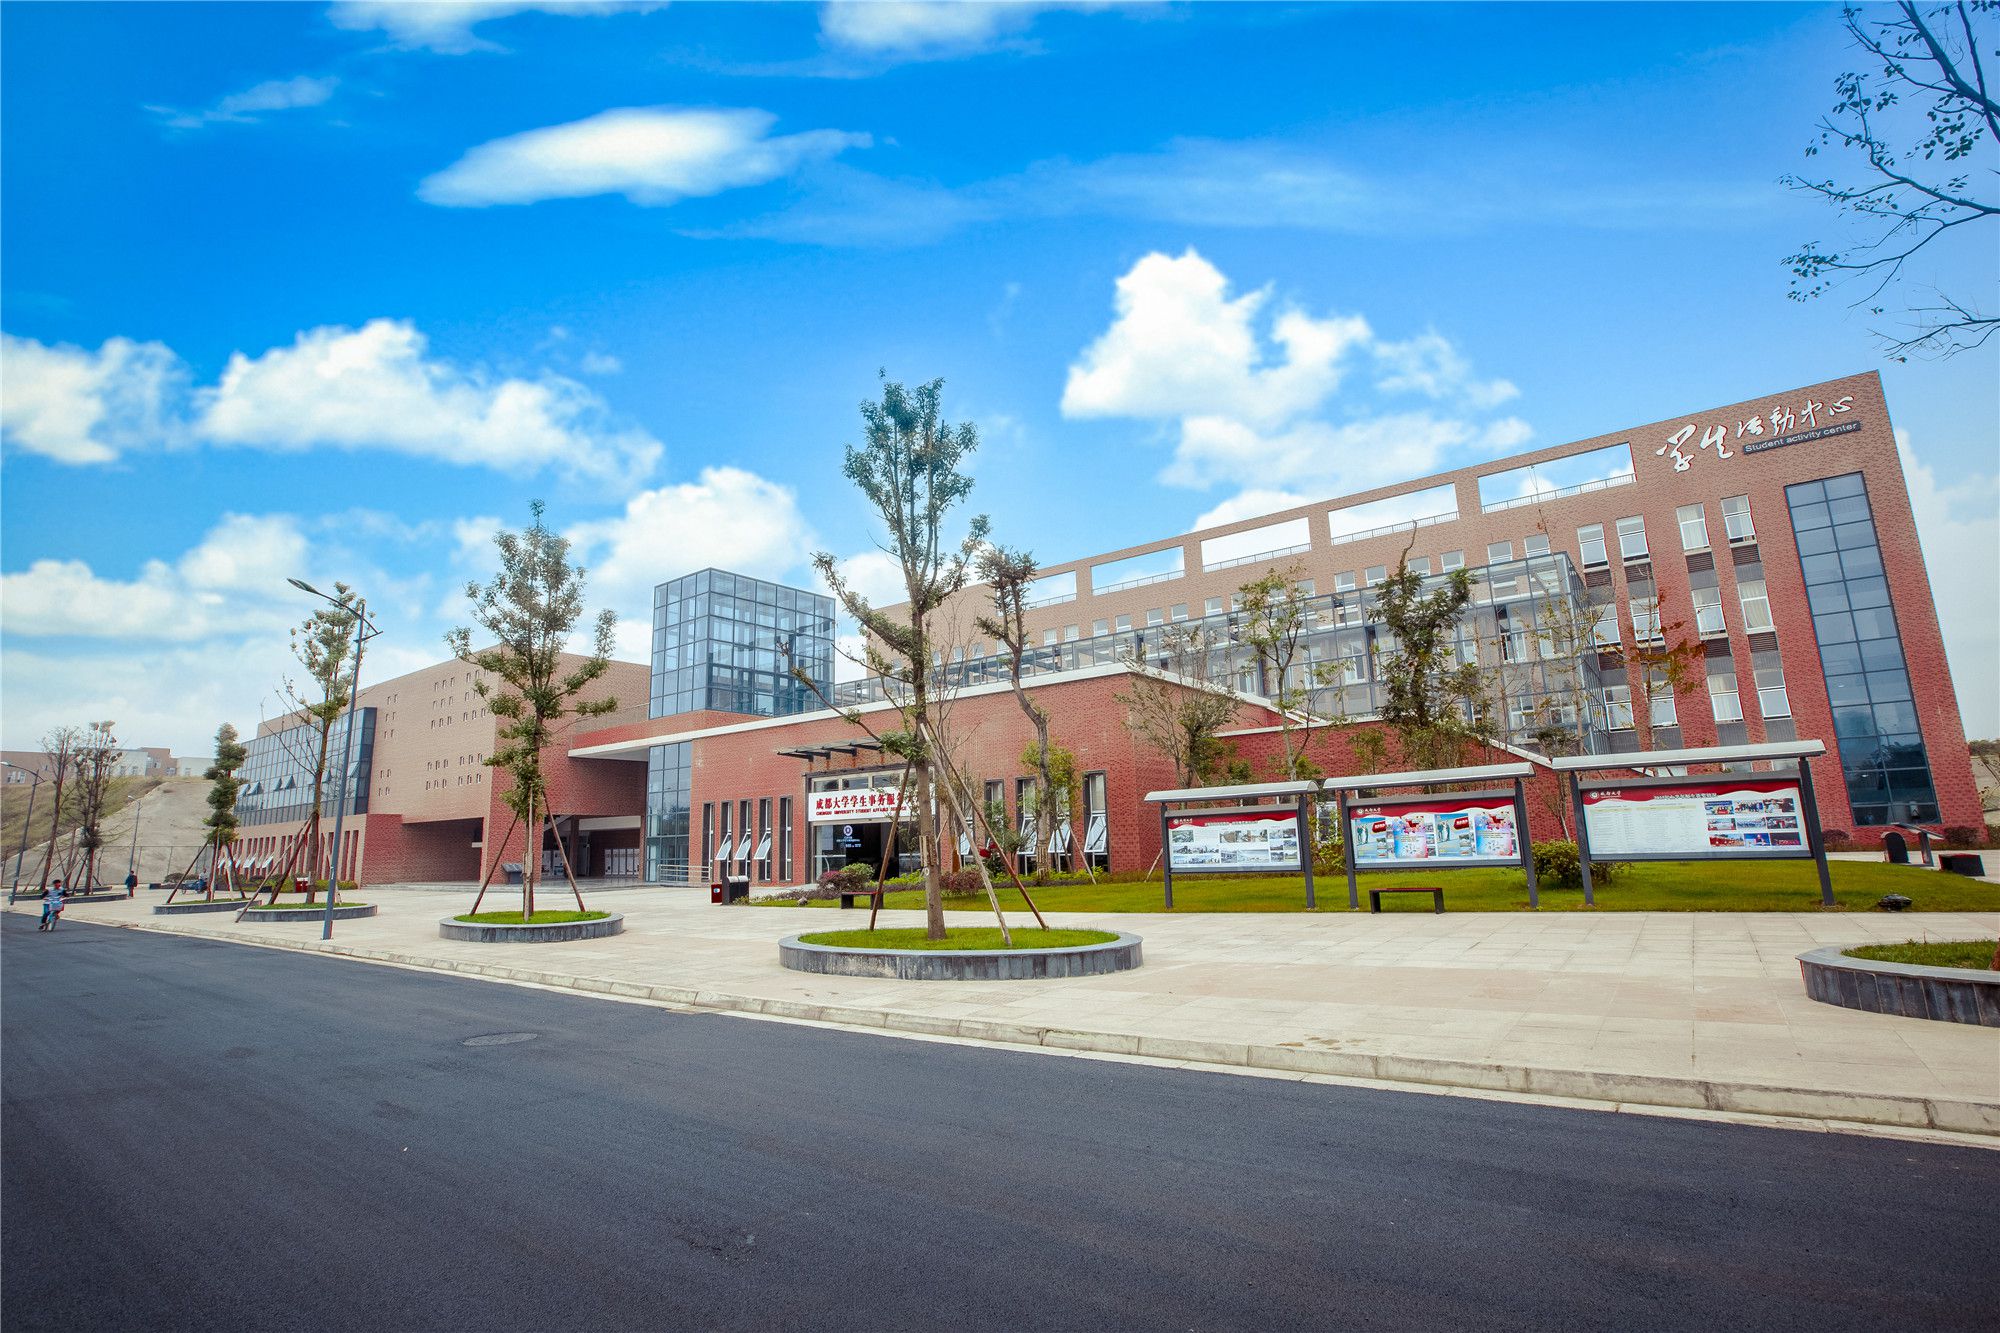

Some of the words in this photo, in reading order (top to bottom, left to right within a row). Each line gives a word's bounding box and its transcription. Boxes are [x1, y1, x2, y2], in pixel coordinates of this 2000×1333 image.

[1745, 438, 1785, 453] Student
[1786, 430, 1822, 444] activity
[1823, 423, 1858, 436] center
